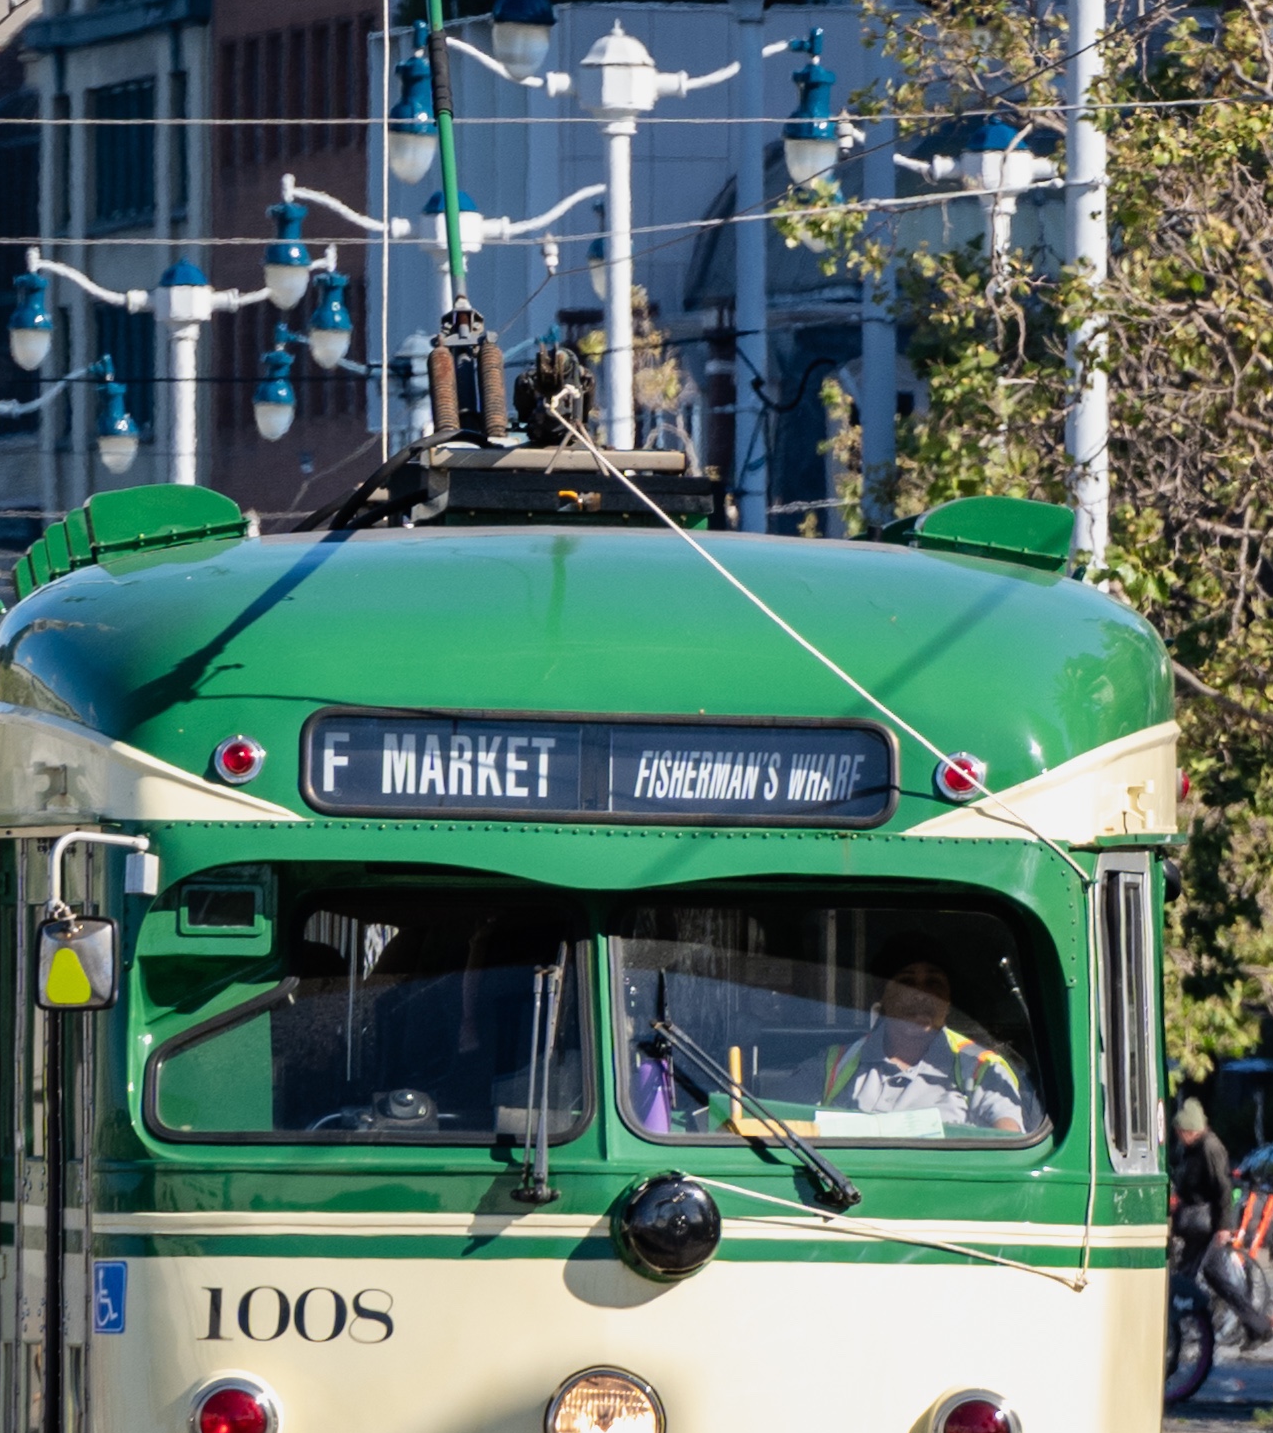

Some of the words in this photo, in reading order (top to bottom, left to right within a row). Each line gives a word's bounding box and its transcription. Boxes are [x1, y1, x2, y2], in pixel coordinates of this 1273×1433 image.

[322, 732, 351, 793] F
[381, 733, 556, 798] MARKET
[634, 749, 781, 801] FISHERMAN'S
[787, 754, 866, 803] WHARF
[196, 1286, 395, 1344] 1008
